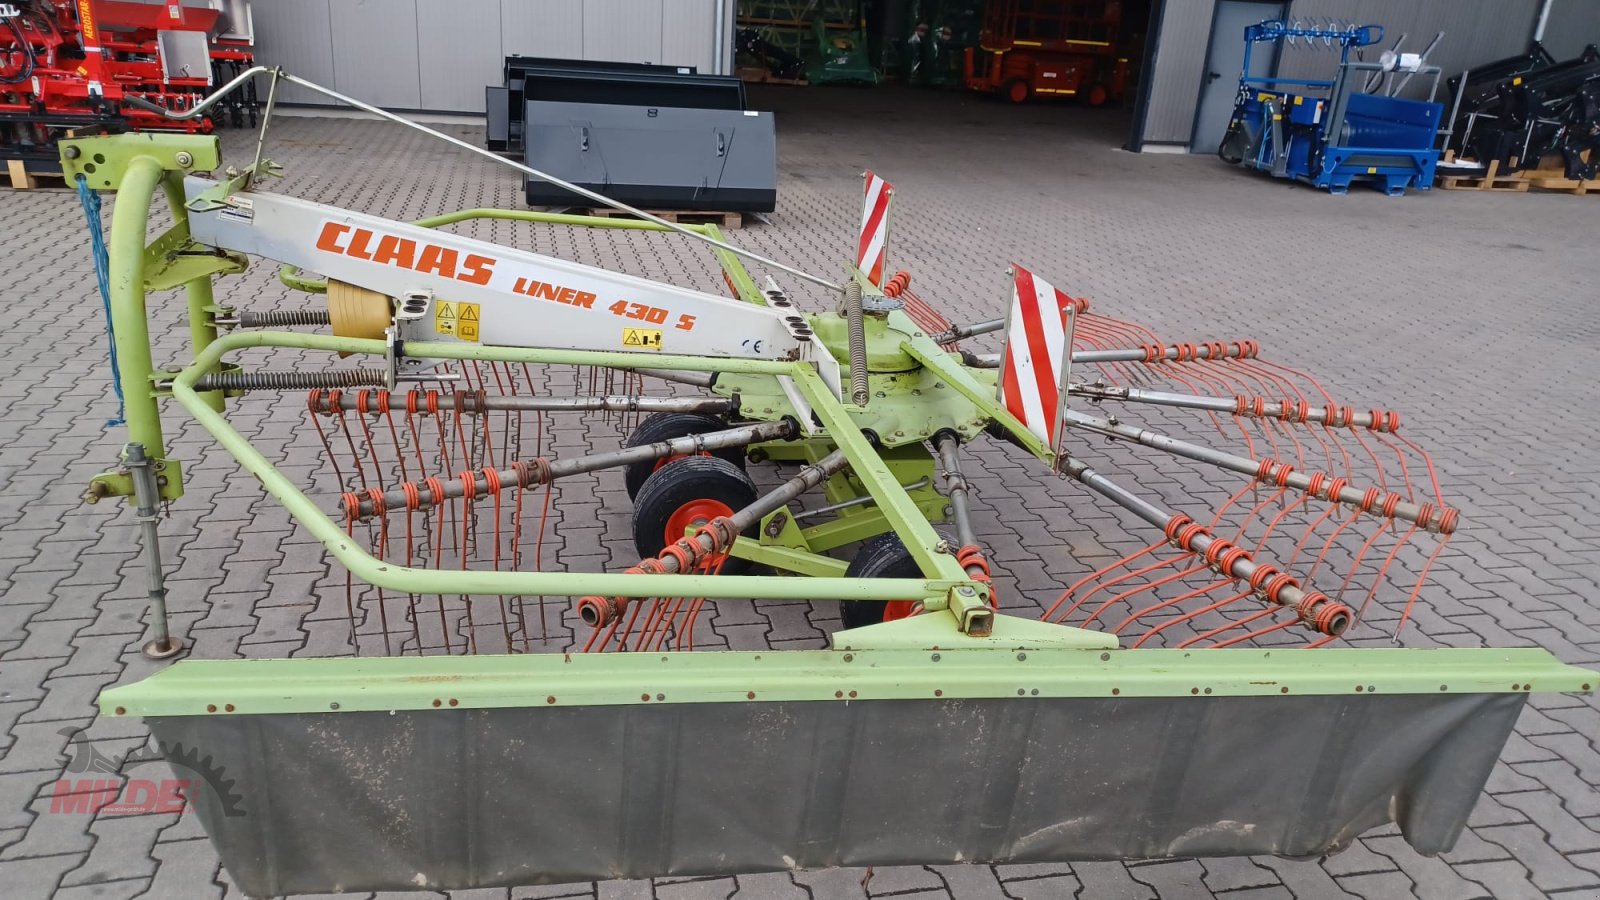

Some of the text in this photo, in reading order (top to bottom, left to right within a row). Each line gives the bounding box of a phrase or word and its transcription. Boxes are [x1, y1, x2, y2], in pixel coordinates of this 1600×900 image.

[316, 222, 496, 285] CLAAS
[512, 277, 697, 331] LINER 430 S
